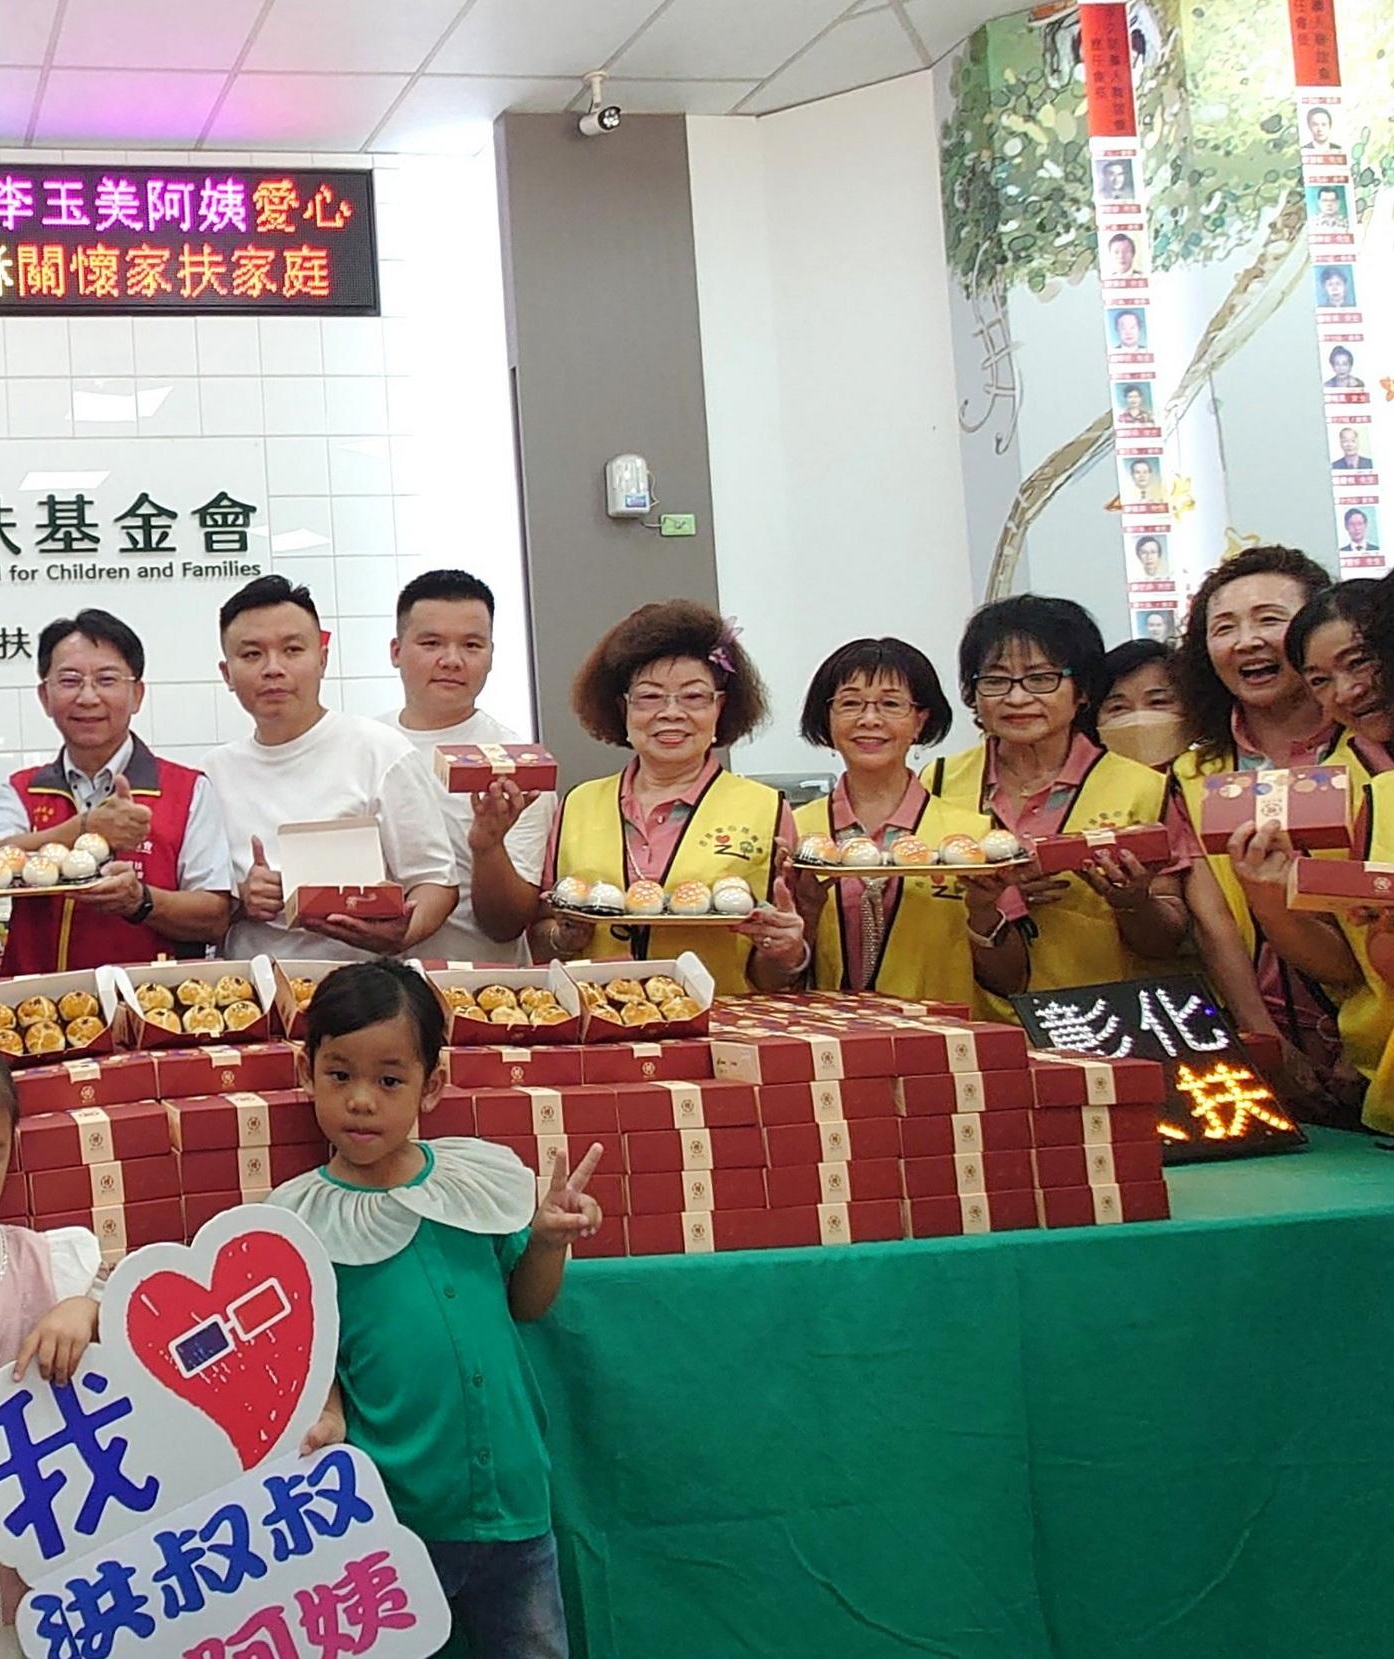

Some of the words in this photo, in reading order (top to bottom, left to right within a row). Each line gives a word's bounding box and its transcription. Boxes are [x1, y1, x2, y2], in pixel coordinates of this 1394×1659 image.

[10, 564, 39, 581] for
[47, 562, 130, 581] Children
[138, 561, 174, 579] and
[183, 561, 261, 577] Families
[1035, 988, 1231, 1059] 彰化
[30, 1449, 374, 1659] 洪叔叔
